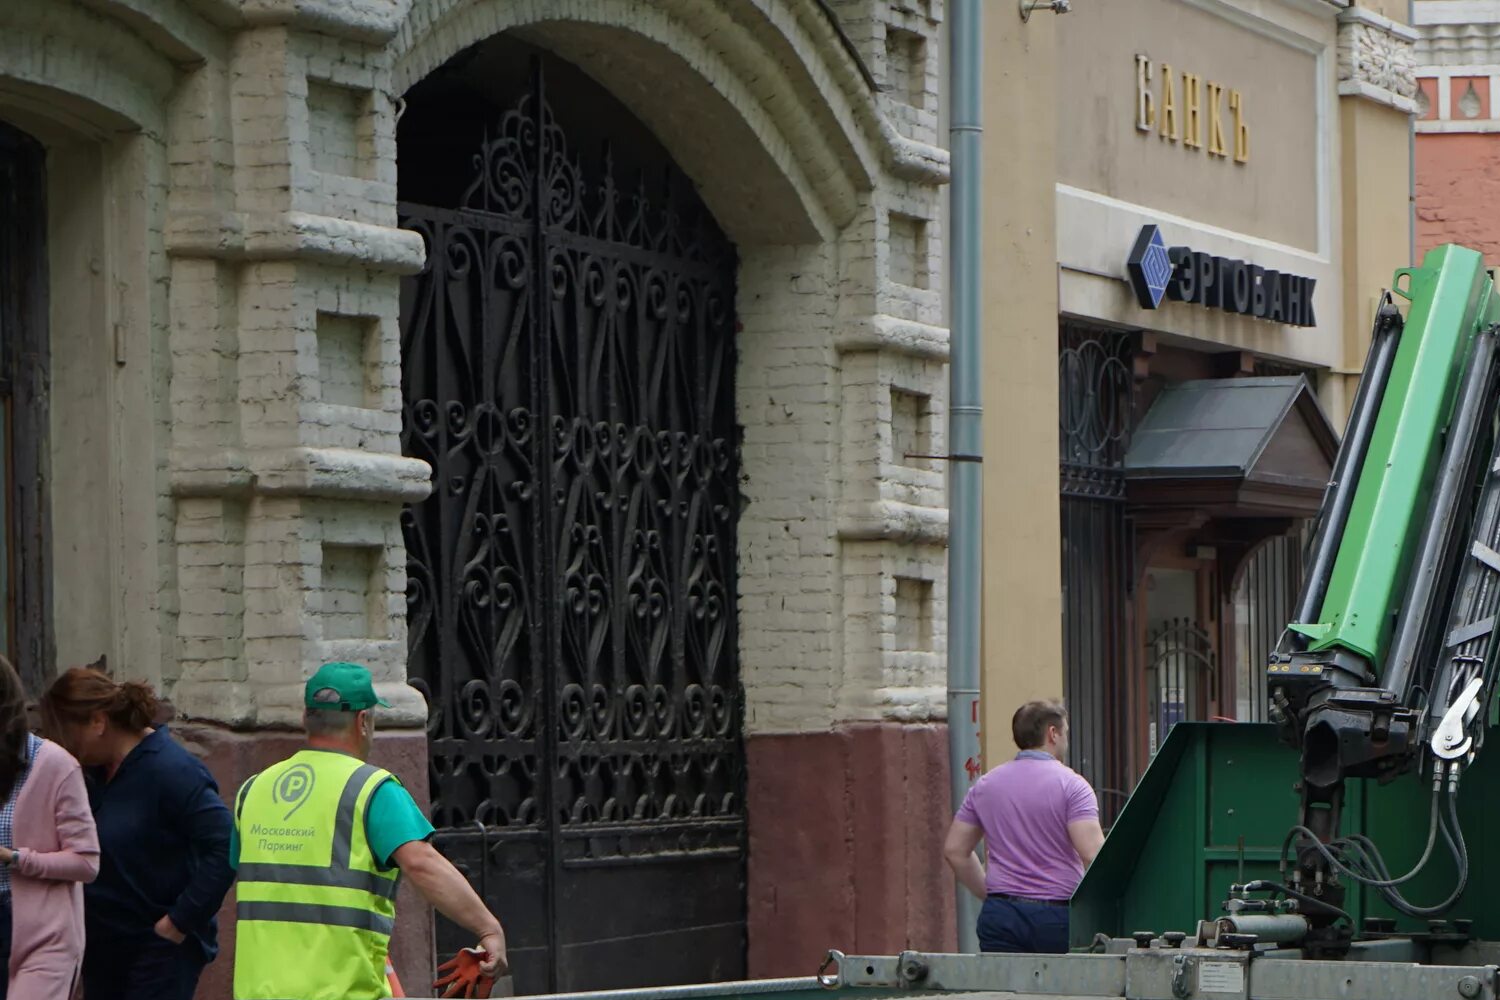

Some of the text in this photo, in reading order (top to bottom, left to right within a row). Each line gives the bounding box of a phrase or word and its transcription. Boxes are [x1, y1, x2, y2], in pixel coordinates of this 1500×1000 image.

[1136, 53, 1248, 164] БАНКЪ
[1171, 247, 1317, 327] ЭРГОБАНК
[250, 823, 316, 837] Московский
[258, 839, 304, 854] Паркинг
